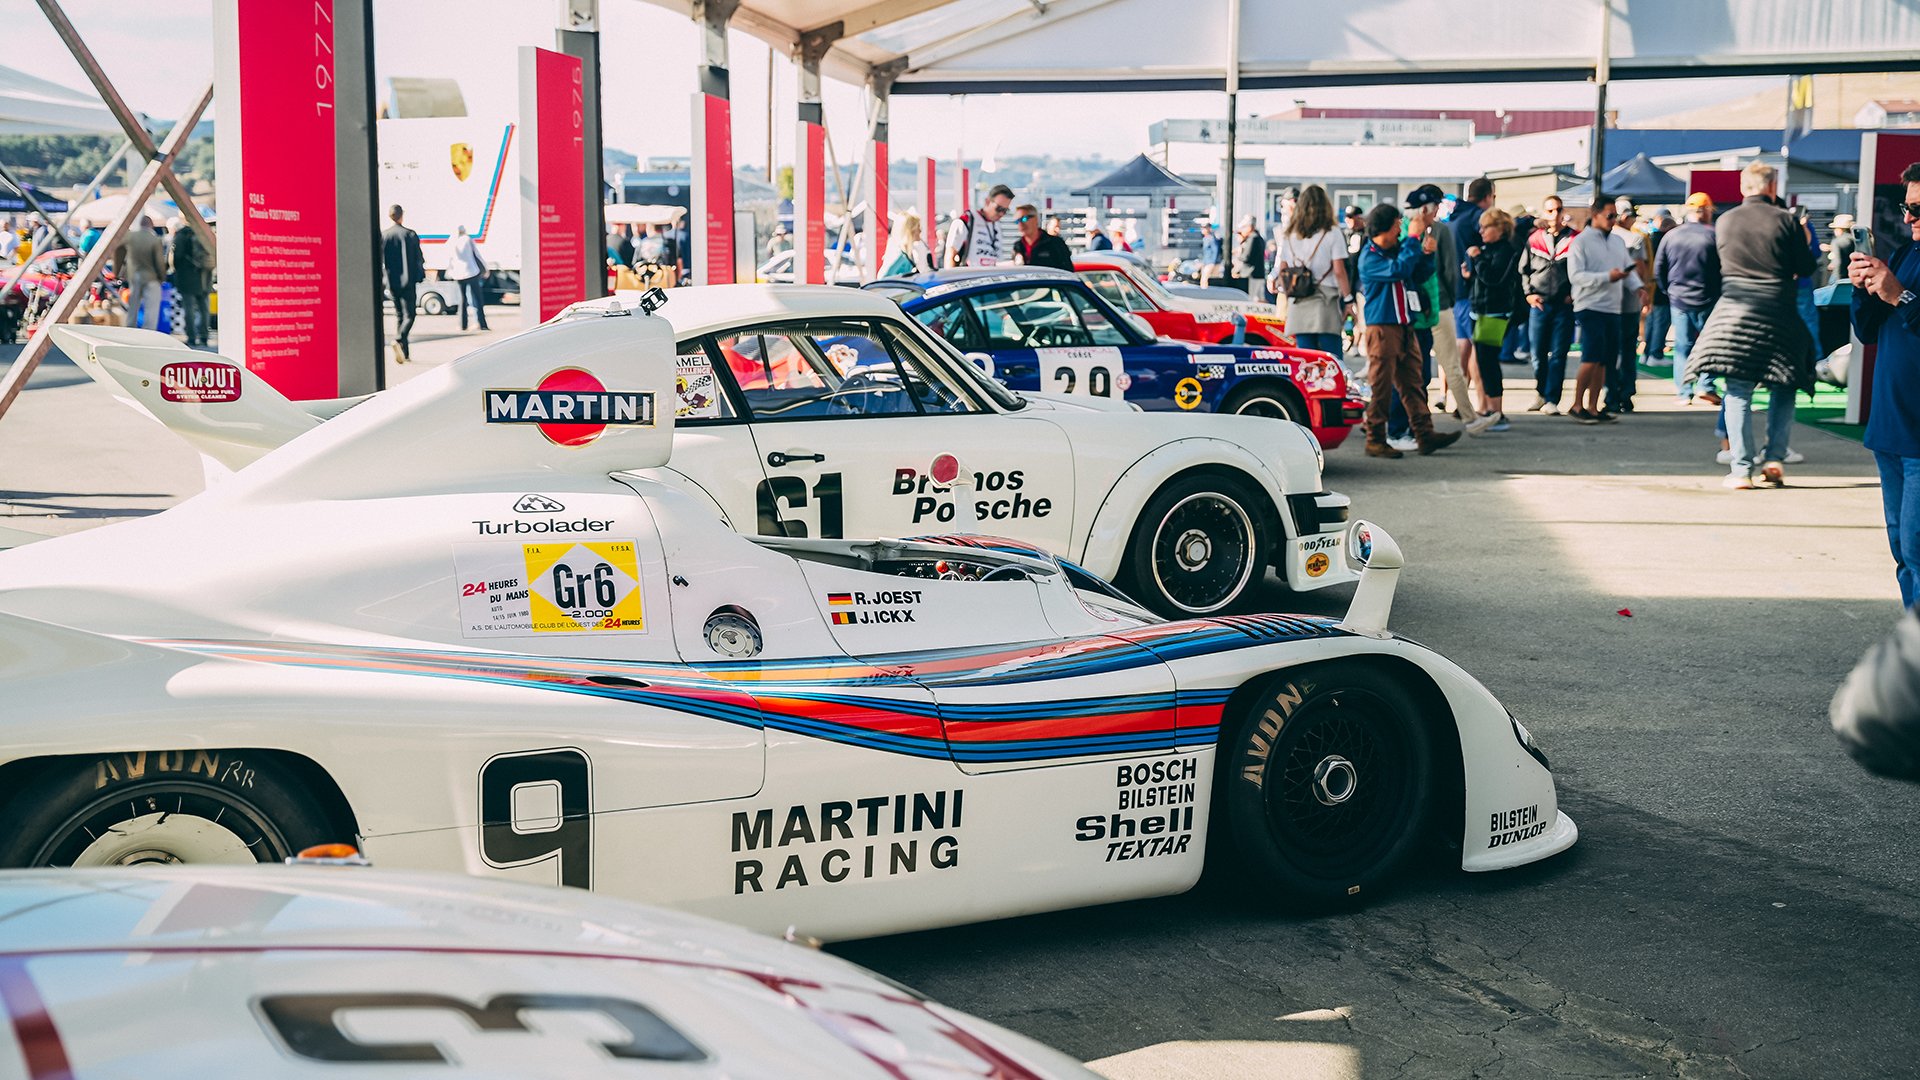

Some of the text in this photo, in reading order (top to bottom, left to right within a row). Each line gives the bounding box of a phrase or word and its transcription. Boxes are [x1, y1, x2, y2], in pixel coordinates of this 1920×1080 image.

[314, 0, 333, 117] 1977
[676, 356, 710, 367] MEL
[1236, 364, 1290, 375] MICHELIN
[1254, 351, 1284, 360] ESSO
[164, 367, 237, 388] GUMOUT
[490, 393, 650, 421] MARTINI
[756, 471, 844, 540] 61
[912, 492, 1052, 524] Posche
[472, 517, 615, 535] Turbolader
[462, 578, 518, 597] 24 HEURES
[490, 589, 529, 604] DU MANS
[553, 562, 616, 609] Gr6
[854, 590, 923, 606] R.JOEST
[859, 608, 916, 625] J.ICKX
[1241, 681, 1303, 789] AVON
[95, 751, 220, 790] AVON
[1117, 757, 1197, 787] BOSCH
[1118, 782, 1195, 810] BILSTEIN
[477, 745, 595, 892] 9
[731, 789, 963, 852] MARTINI
[1075, 806, 1194, 841] Shell
[1490, 804, 1538, 832] BILSTEIN
[1105, 834, 1192, 862] TEXTAR
[1487, 820, 1547, 849] DUNLOP
[734, 835, 959, 895] RACING
